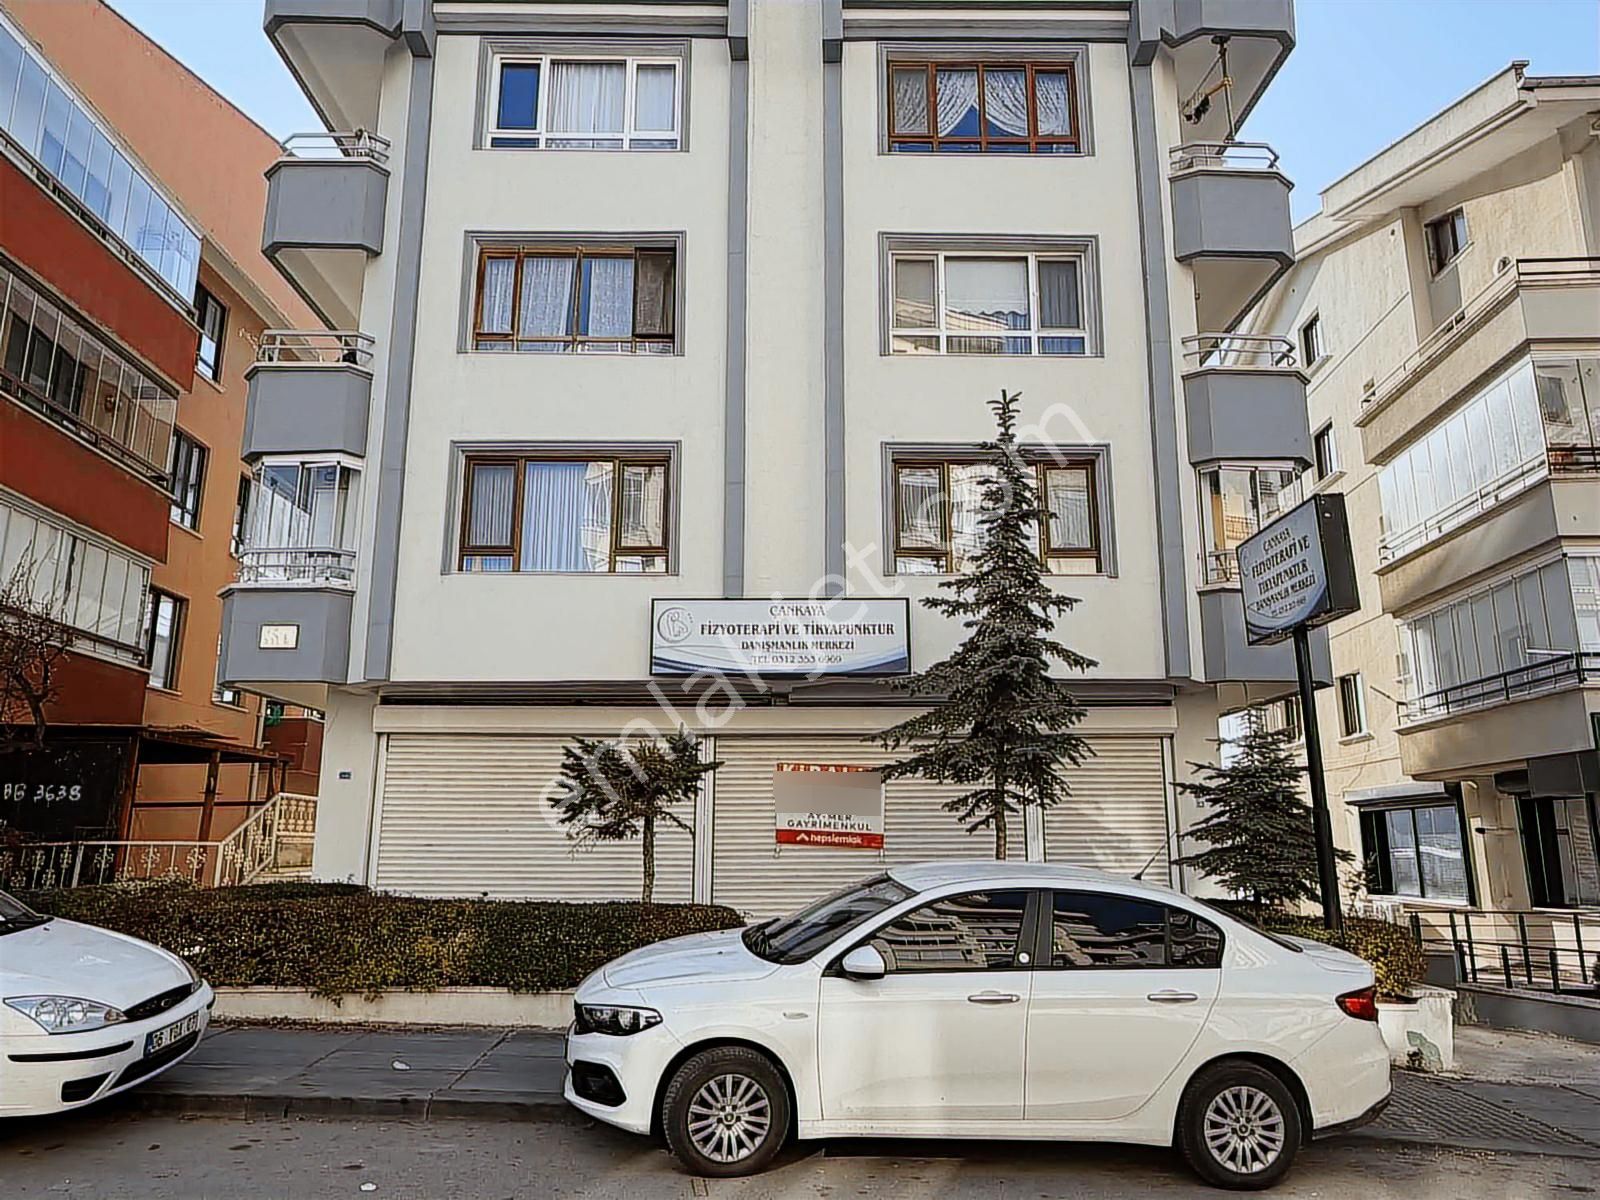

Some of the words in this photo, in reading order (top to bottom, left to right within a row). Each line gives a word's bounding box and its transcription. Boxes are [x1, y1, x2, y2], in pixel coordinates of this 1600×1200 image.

[769, 605, 826, 619] ÇANKAYA
[700, 620, 780, 636] FİZYOTERAPİ
[783, 623, 800, 636] VE
[741, 640, 809, 652] DANIŞMANLIK
[811, 638, 855, 650] MERKEZİ
